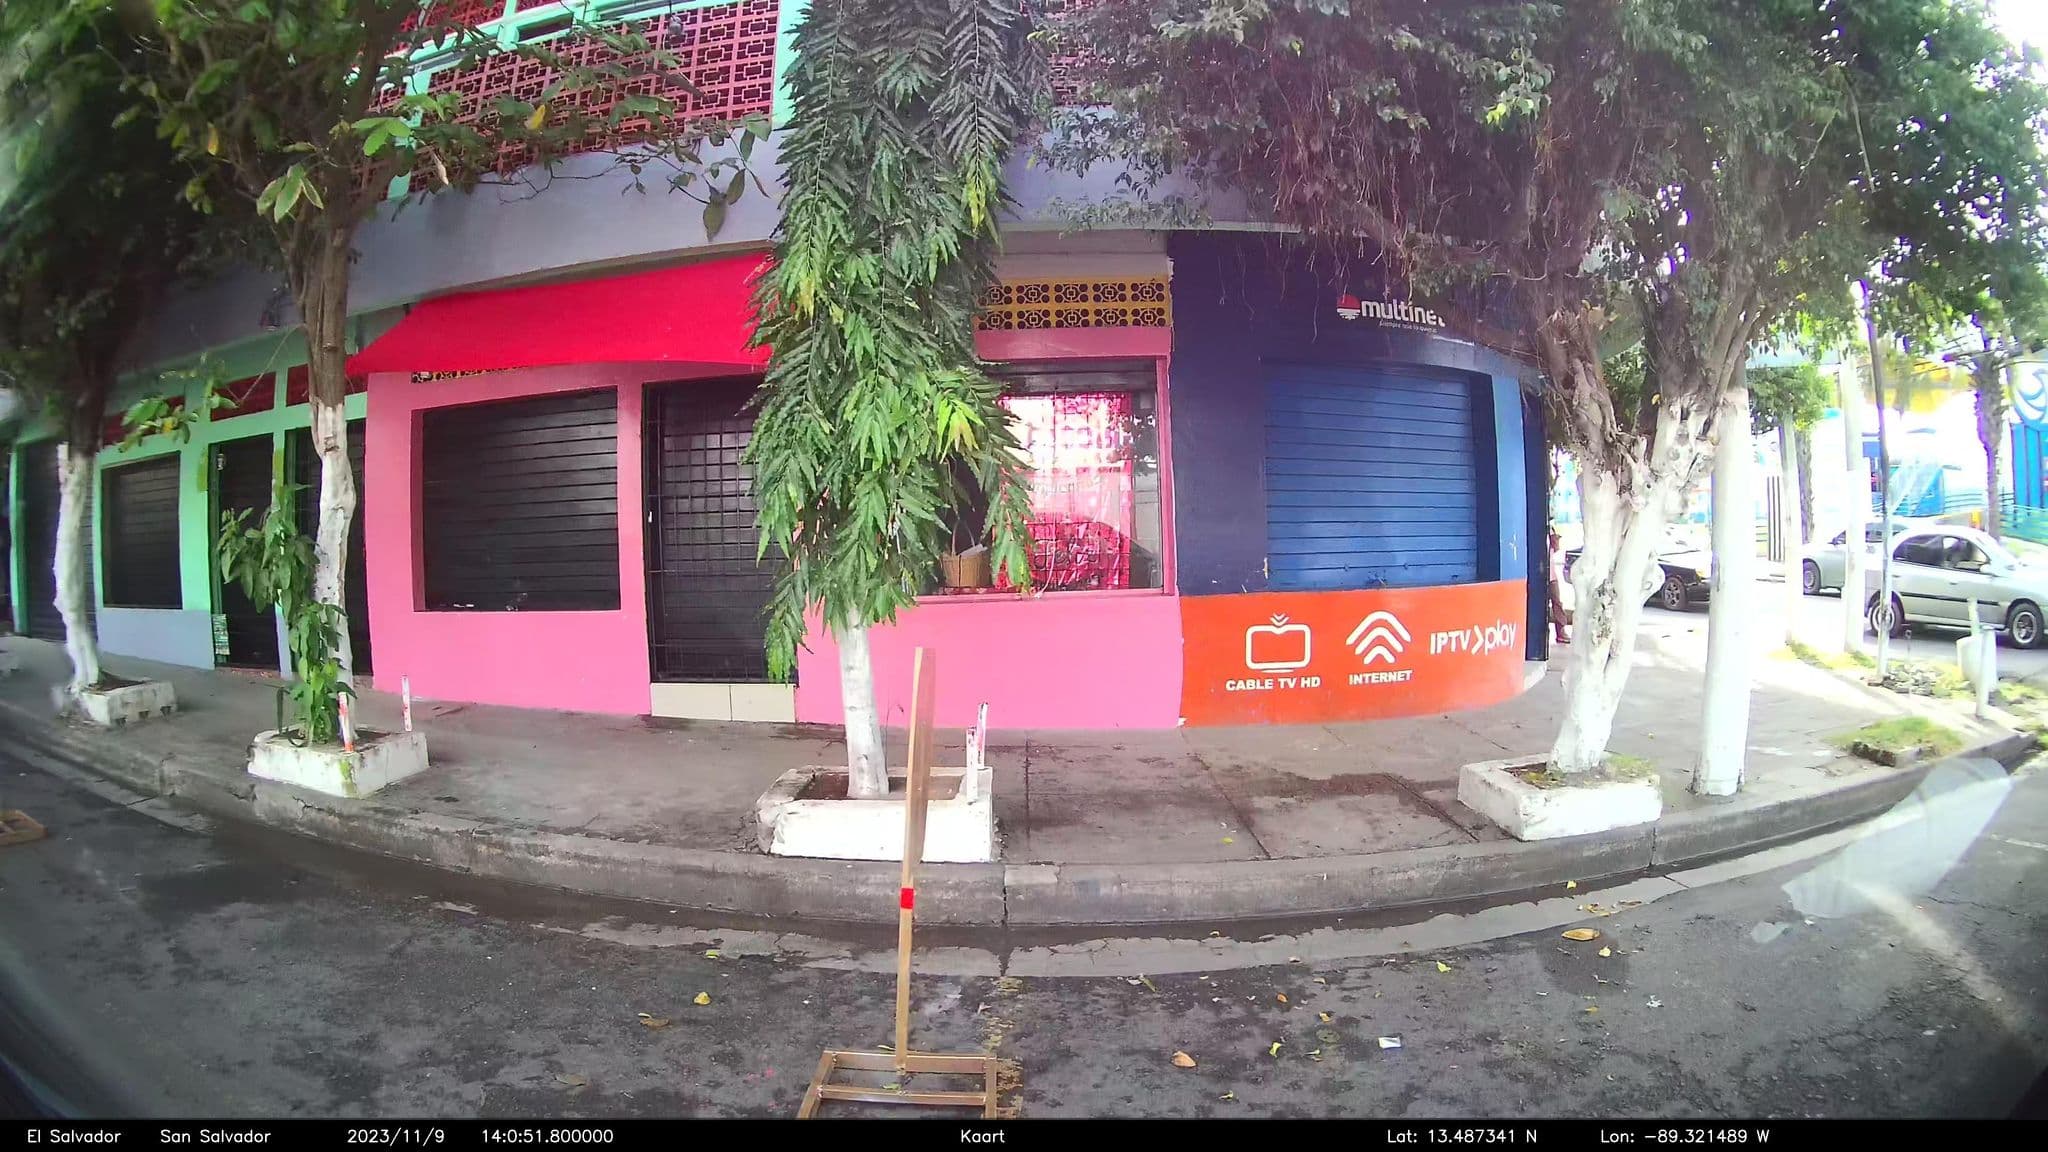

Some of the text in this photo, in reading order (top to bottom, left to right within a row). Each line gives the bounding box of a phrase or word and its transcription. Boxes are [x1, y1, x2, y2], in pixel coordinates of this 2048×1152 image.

[1429, 618, 1517, 656] IPTV play
[1225, 675, 1321, 691] CABLE TV HD
[1348, 669, 1413, 686] INTERNET
